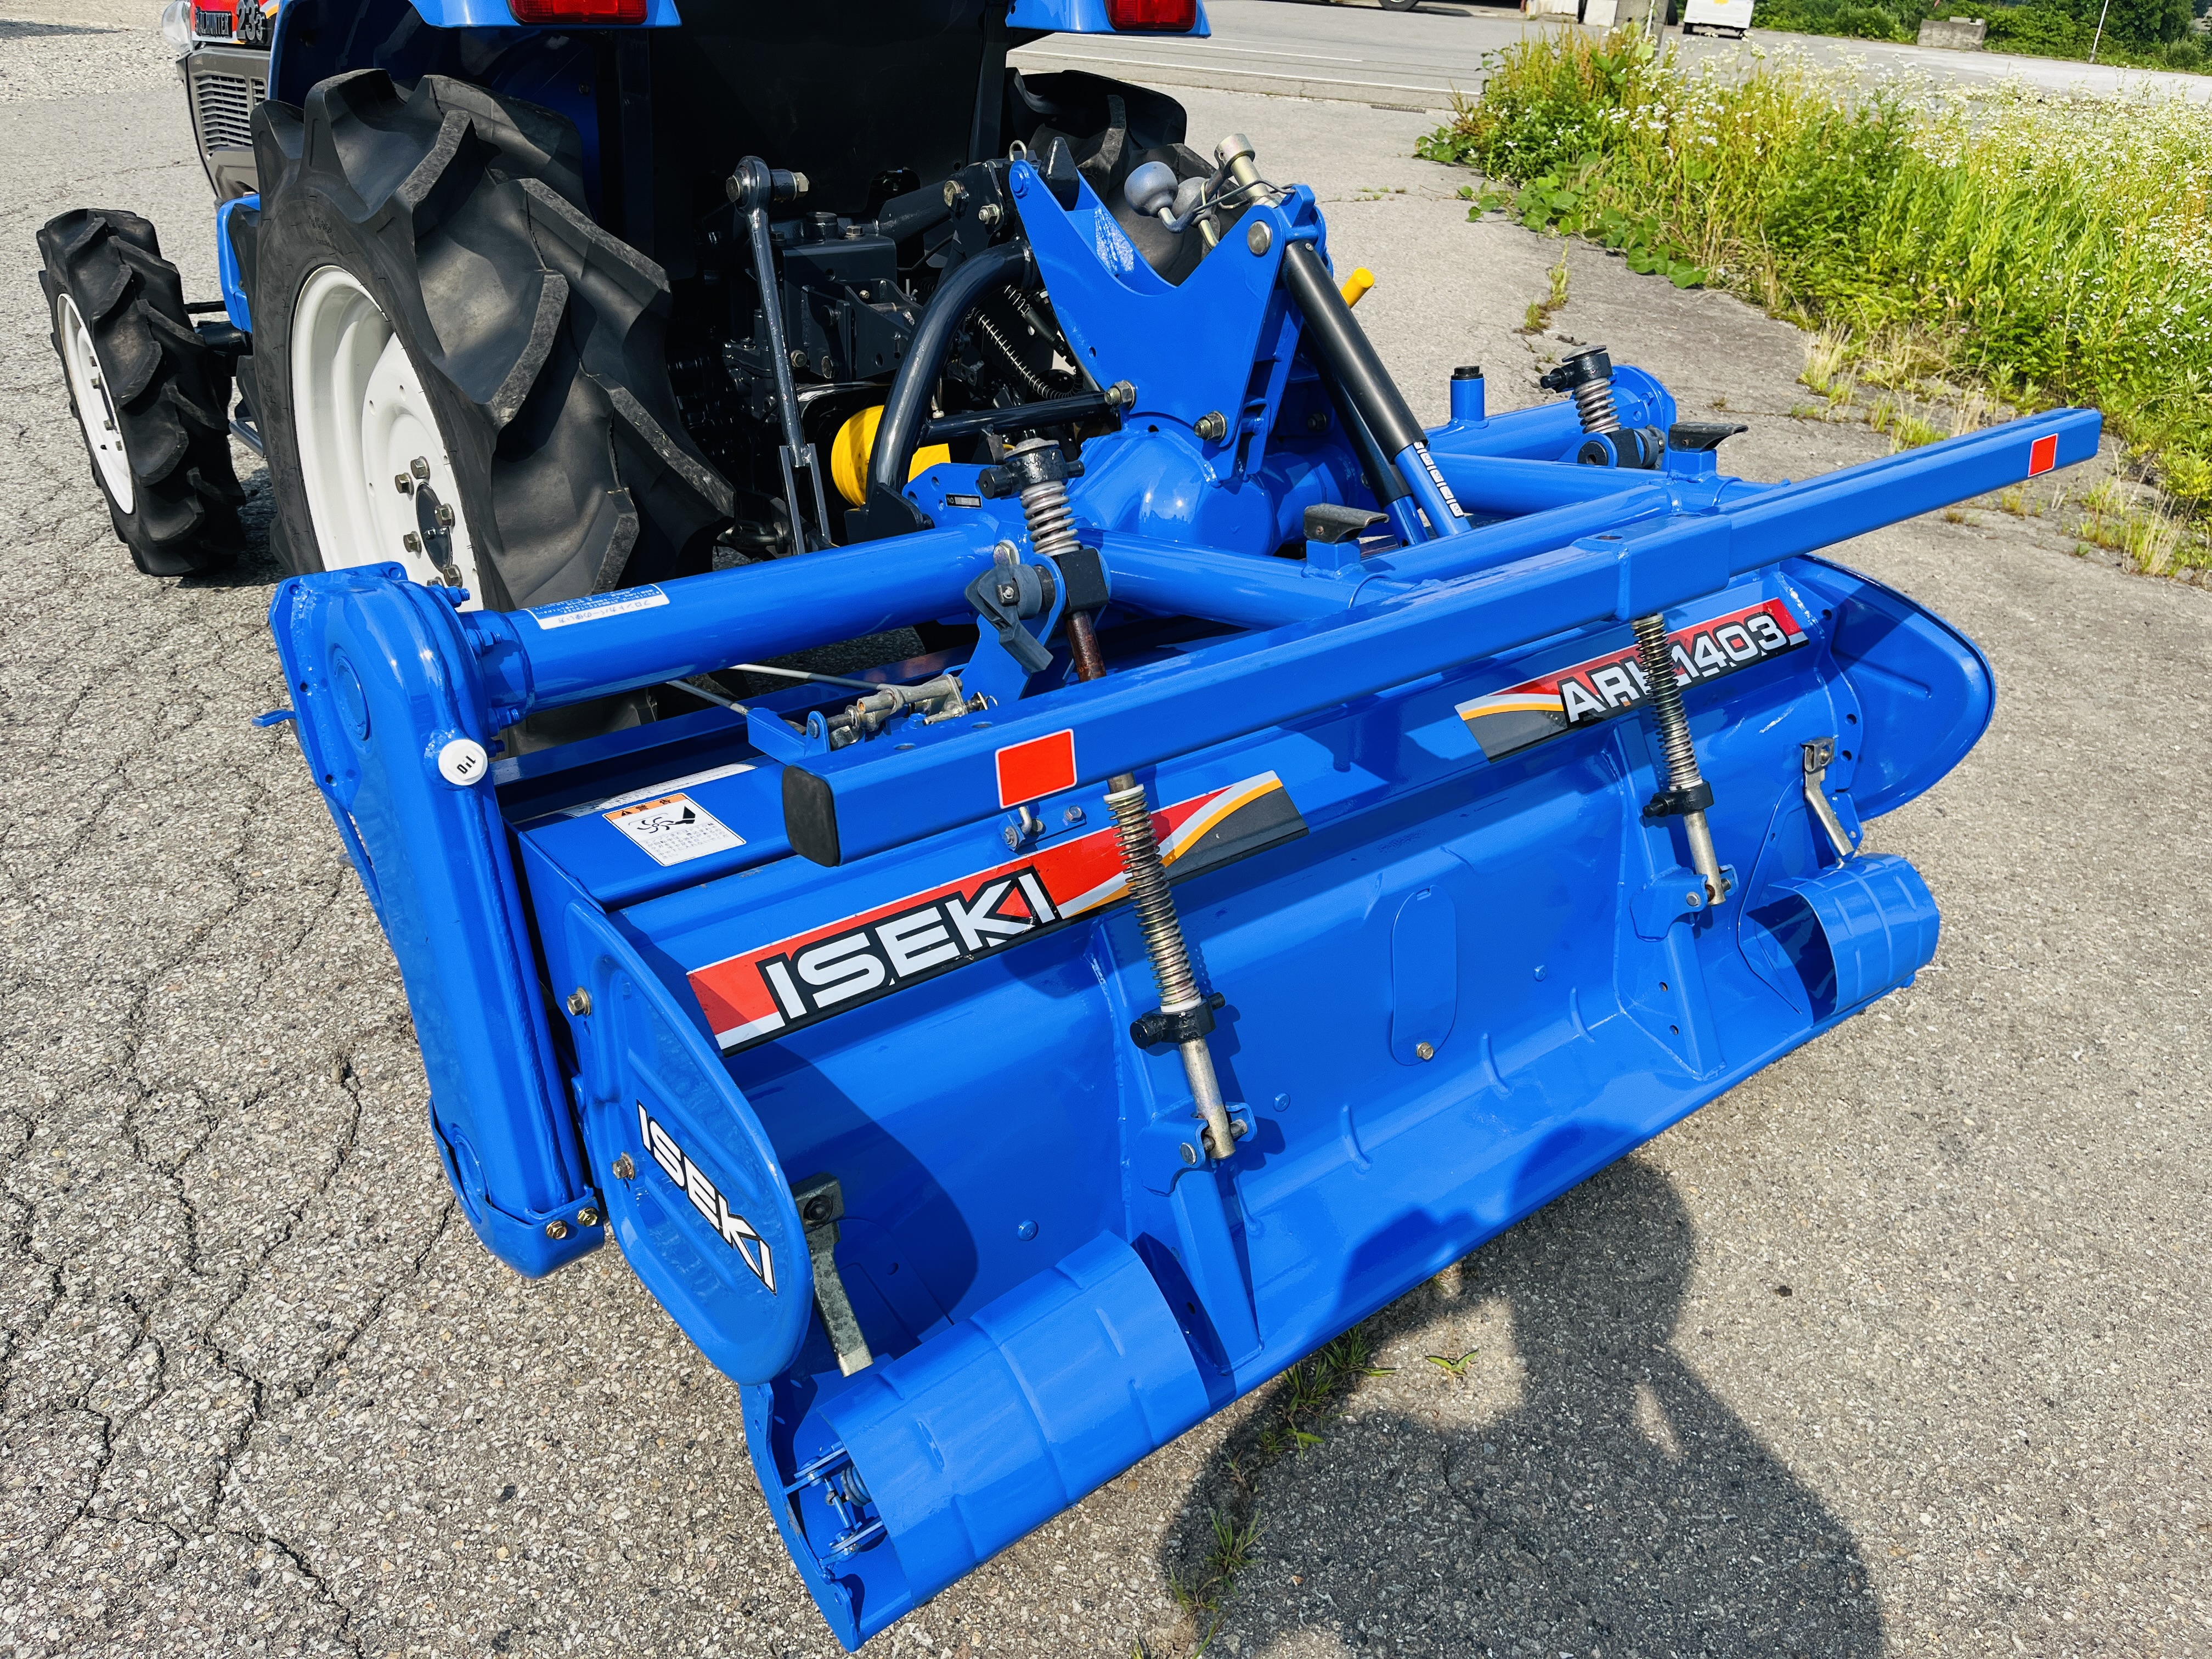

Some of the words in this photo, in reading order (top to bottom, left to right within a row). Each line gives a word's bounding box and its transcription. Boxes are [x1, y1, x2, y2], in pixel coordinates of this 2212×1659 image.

[558, 600, 652, 623] フロントカバーの使い方
[765, 872, 1056, 1019] ISEKI
[638, 1104, 774, 1290] ISEKI
